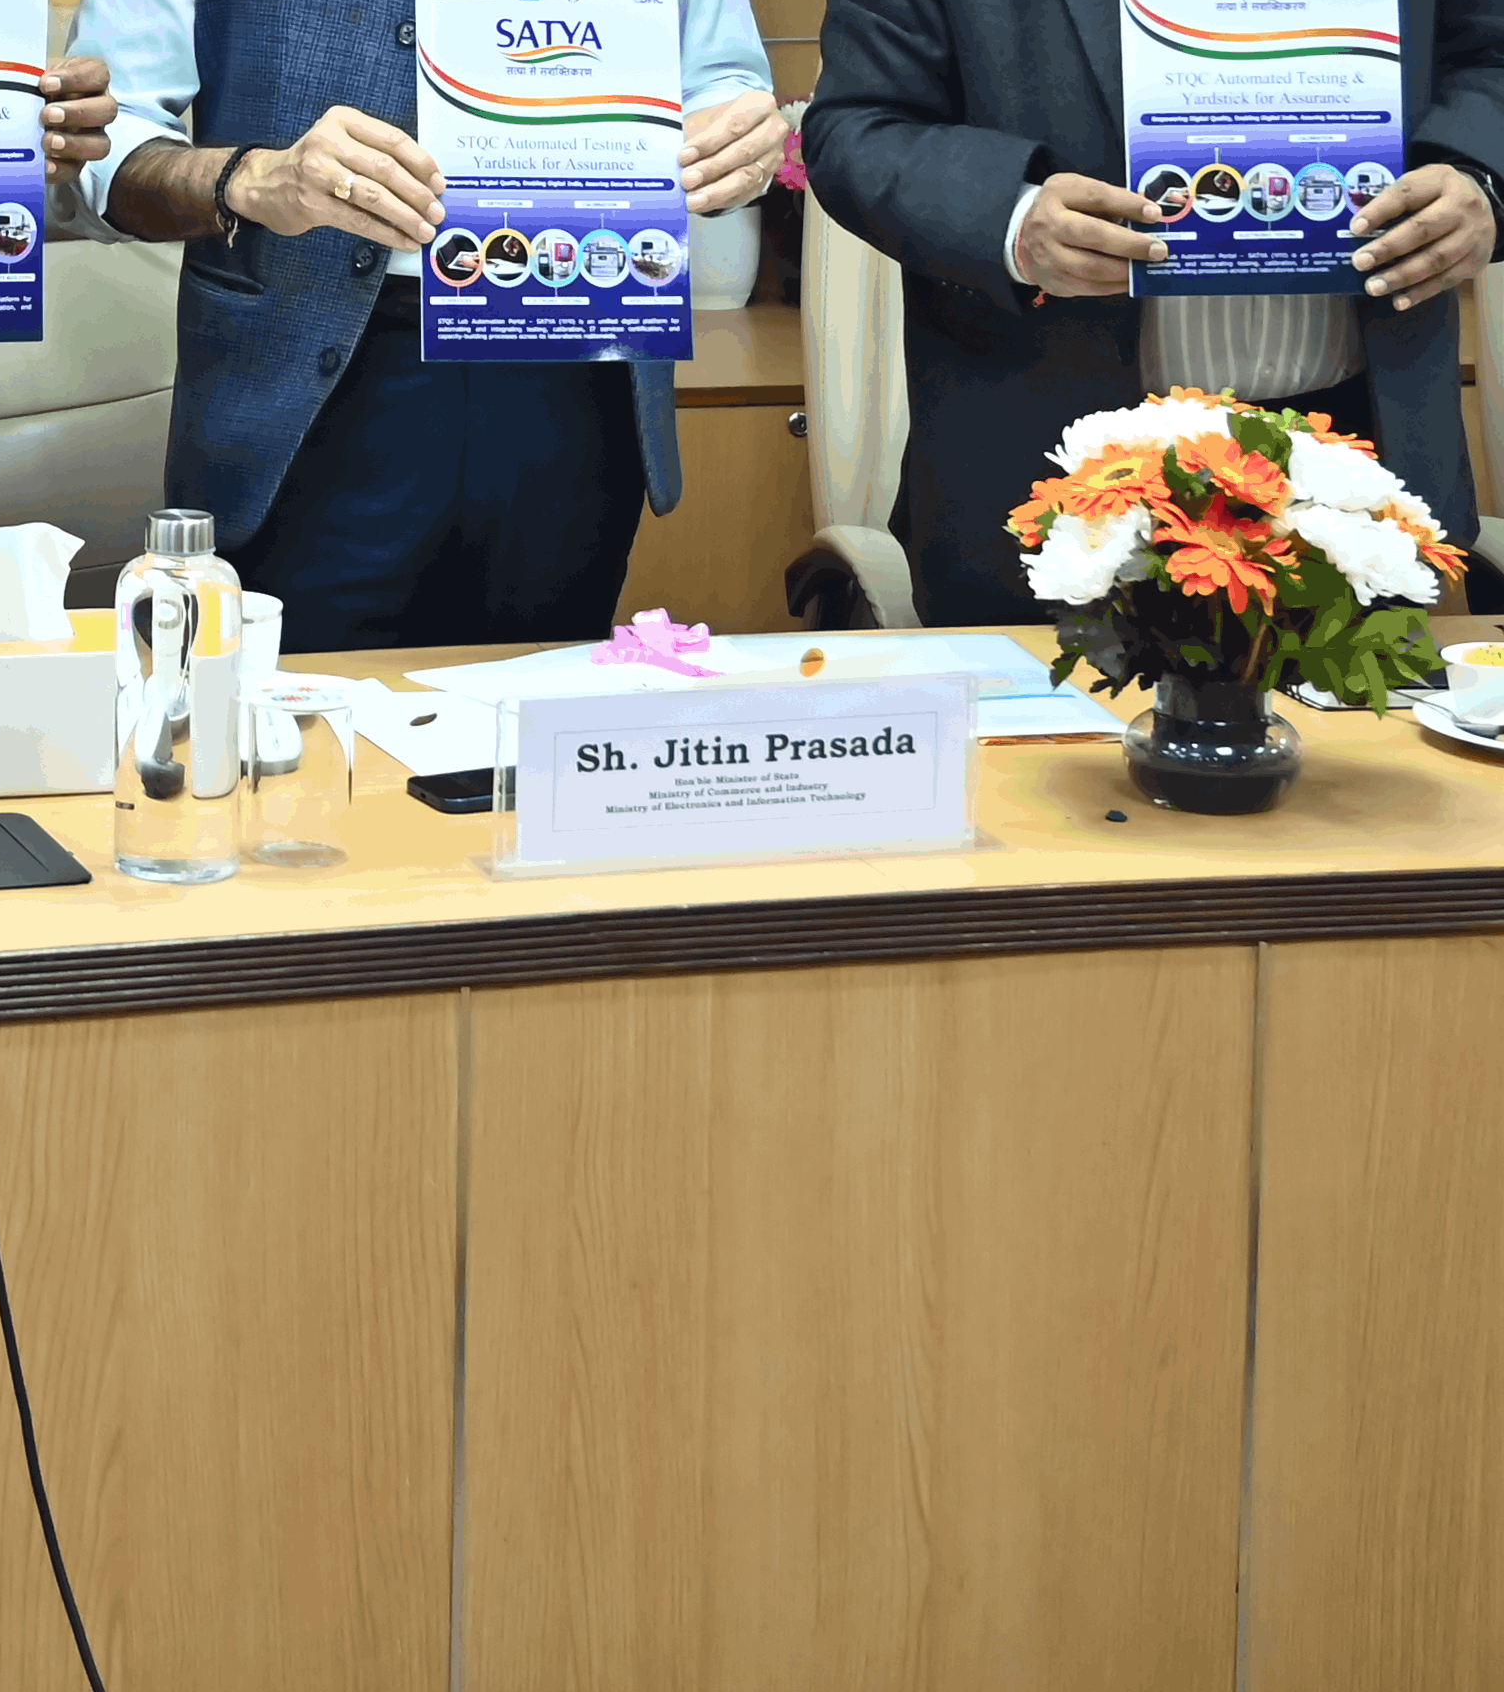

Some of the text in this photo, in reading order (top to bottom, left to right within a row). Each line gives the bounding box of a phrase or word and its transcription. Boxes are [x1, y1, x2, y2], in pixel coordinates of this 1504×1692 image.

[496, 19, 602, 50] SATYA
[1164, 72, 1364, 87] STQC Automated Testing &
[1182, 92, 1350, 106] Yardstick for Assurance
[457, 137, 648, 153] STQC Automated Testing &
[473, 156, 634, 171] Yardstick for Assurance
[576, 726, 916, 772] Sh. Jitin Prasada
[715, 776, 757, 784] Minister
[760, 774, 772, 782] of
[774, 772, 799, 781] State
[649, 782, 828, 800] Ministry of Commerce and Industry
[606, 790, 866, 815] Ministry of Electronics and Information Technology
